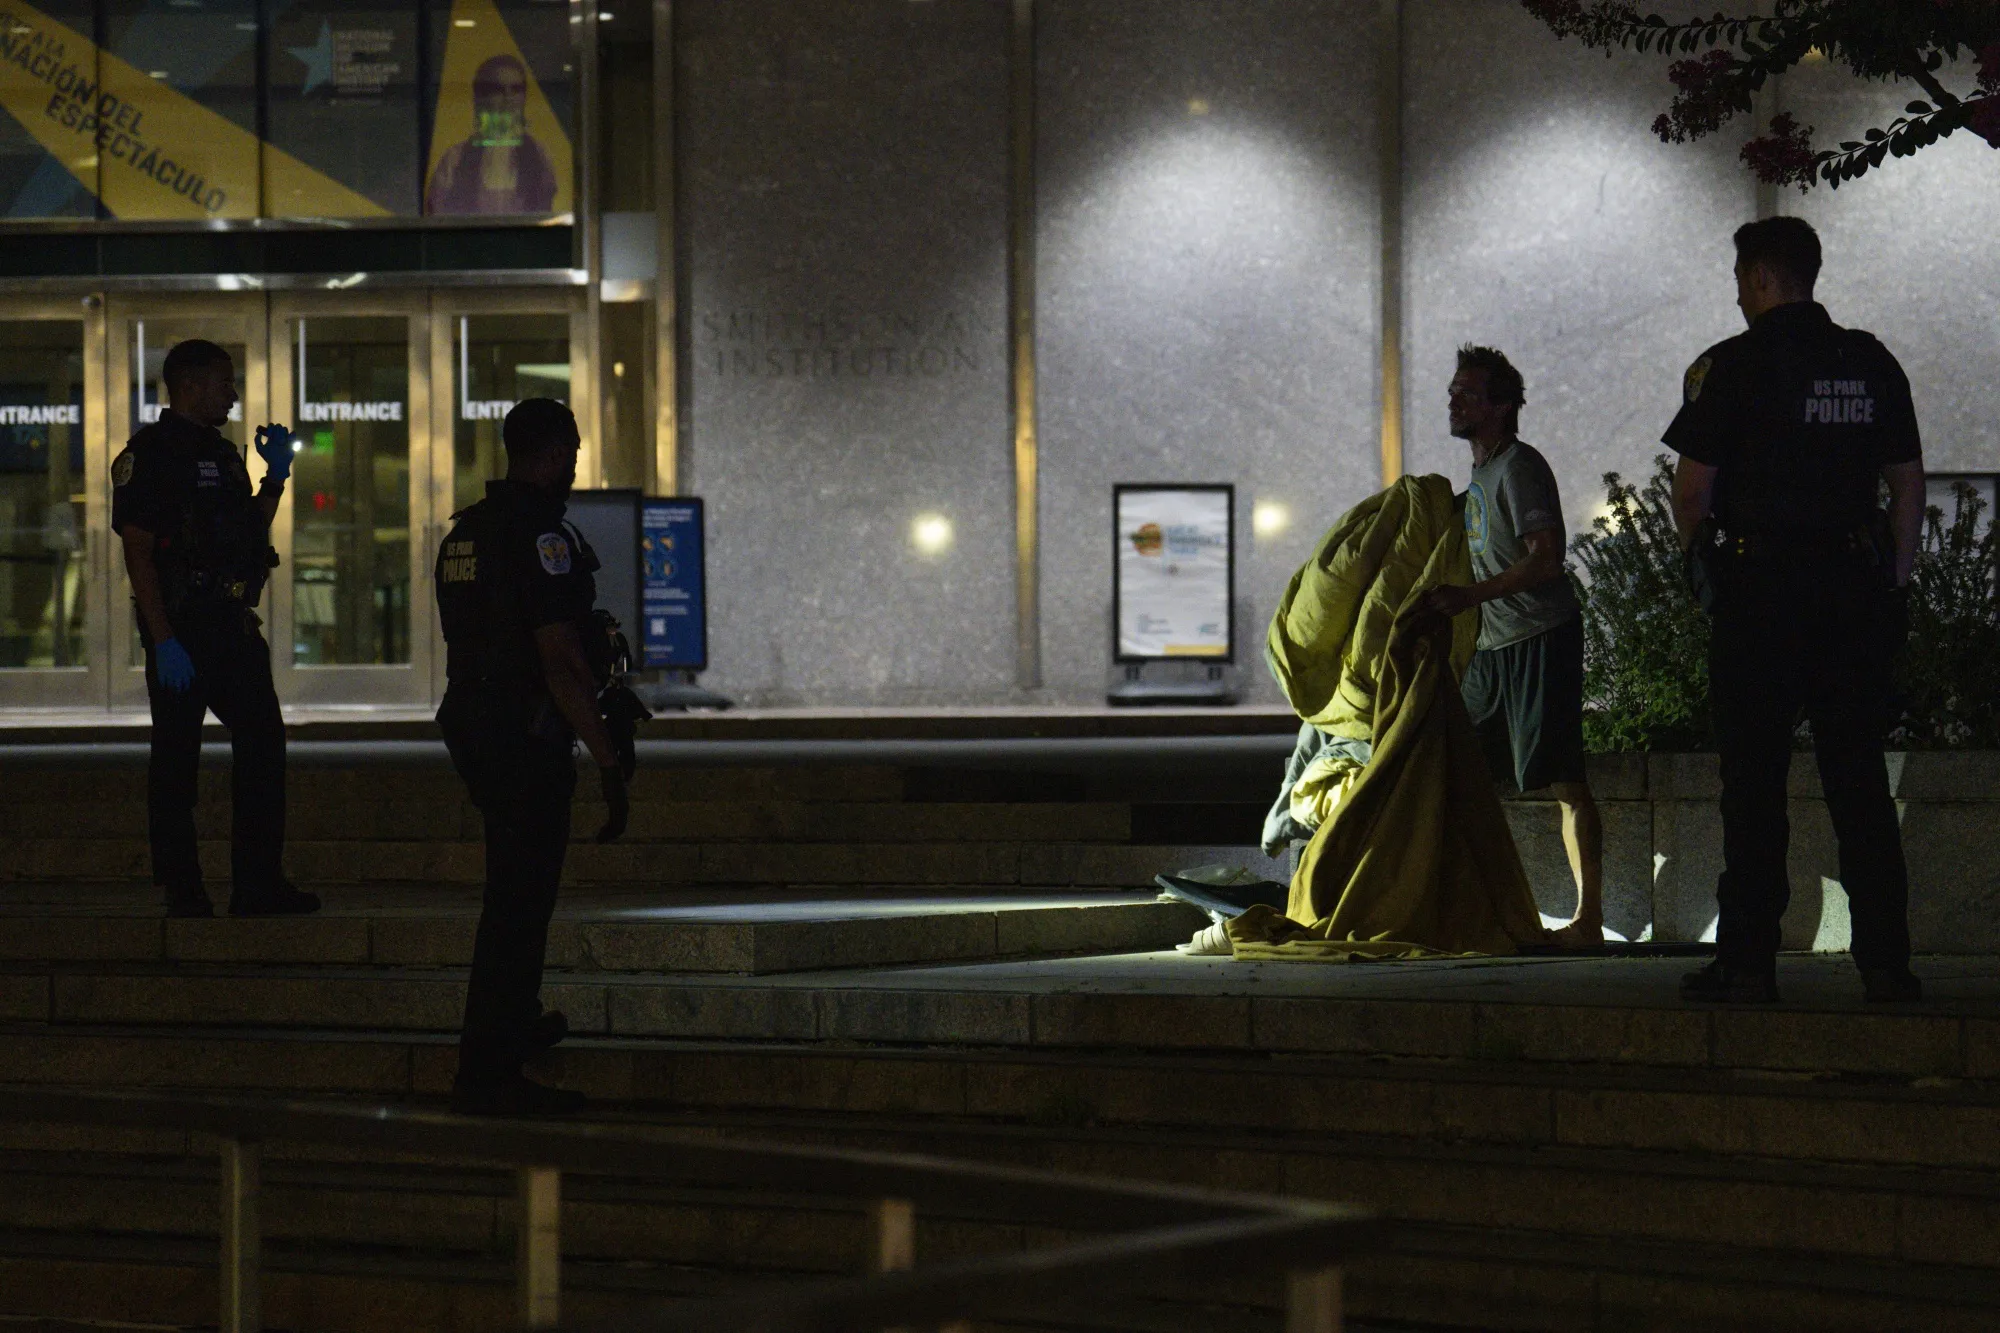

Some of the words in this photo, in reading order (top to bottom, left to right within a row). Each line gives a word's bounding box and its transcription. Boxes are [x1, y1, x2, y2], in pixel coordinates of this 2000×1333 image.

[1, 33, 97, 105] NACIÓN
[98, 92, 143, 137] DEL
[45, 94, 226, 211] ESPECTÁCULO
[703, 311, 991, 344] SMITHSONAN
[716, 346, 980, 377] INSTITUTION
[1814, 379, 1831, 397] US
[1833, 379, 1867, 396] PARK
[0, 405, 80, 424] NTRANCE
[303, 401, 403, 421] ENTRANCE
[1804, 397, 1875, 424] POLICE
[443, 557, 478, 584] POLICE
